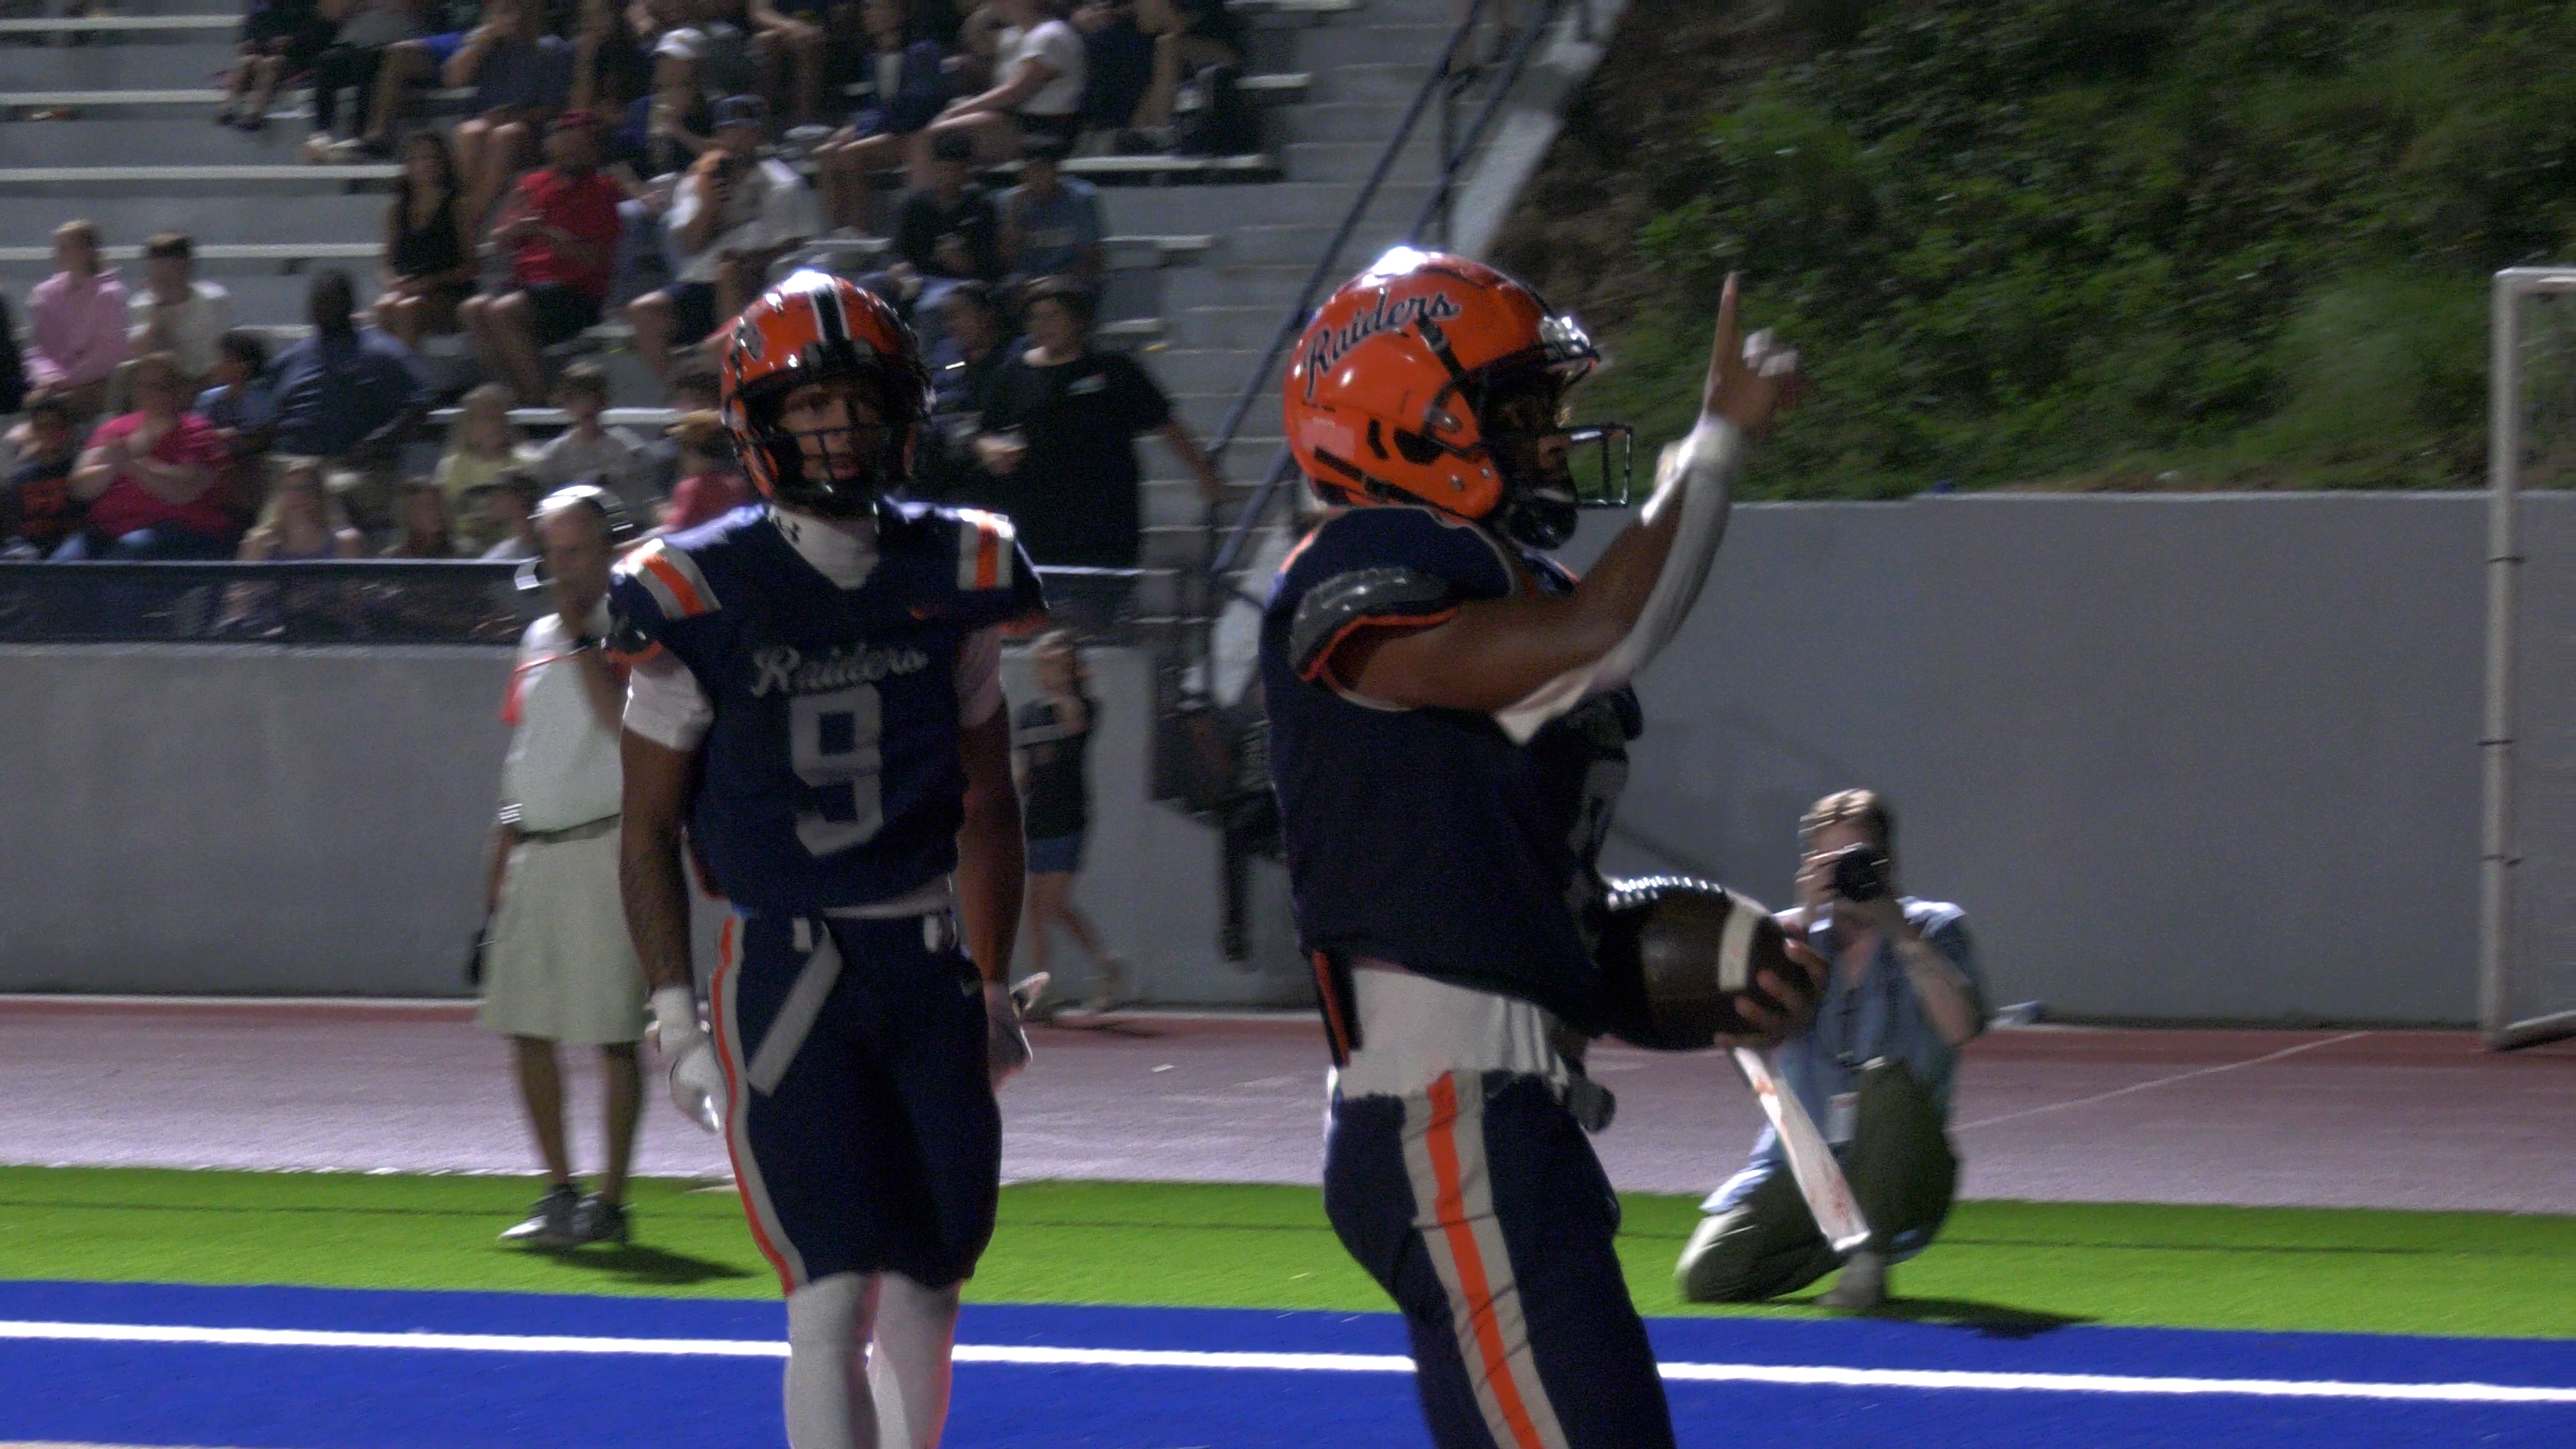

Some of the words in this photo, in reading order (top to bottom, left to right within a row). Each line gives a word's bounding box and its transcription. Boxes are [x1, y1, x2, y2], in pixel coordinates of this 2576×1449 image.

[1303, 288, 1462, 399] Raiders
[751, 642, 929, 698] Raiders
[790, 683, 884, 857] 9
